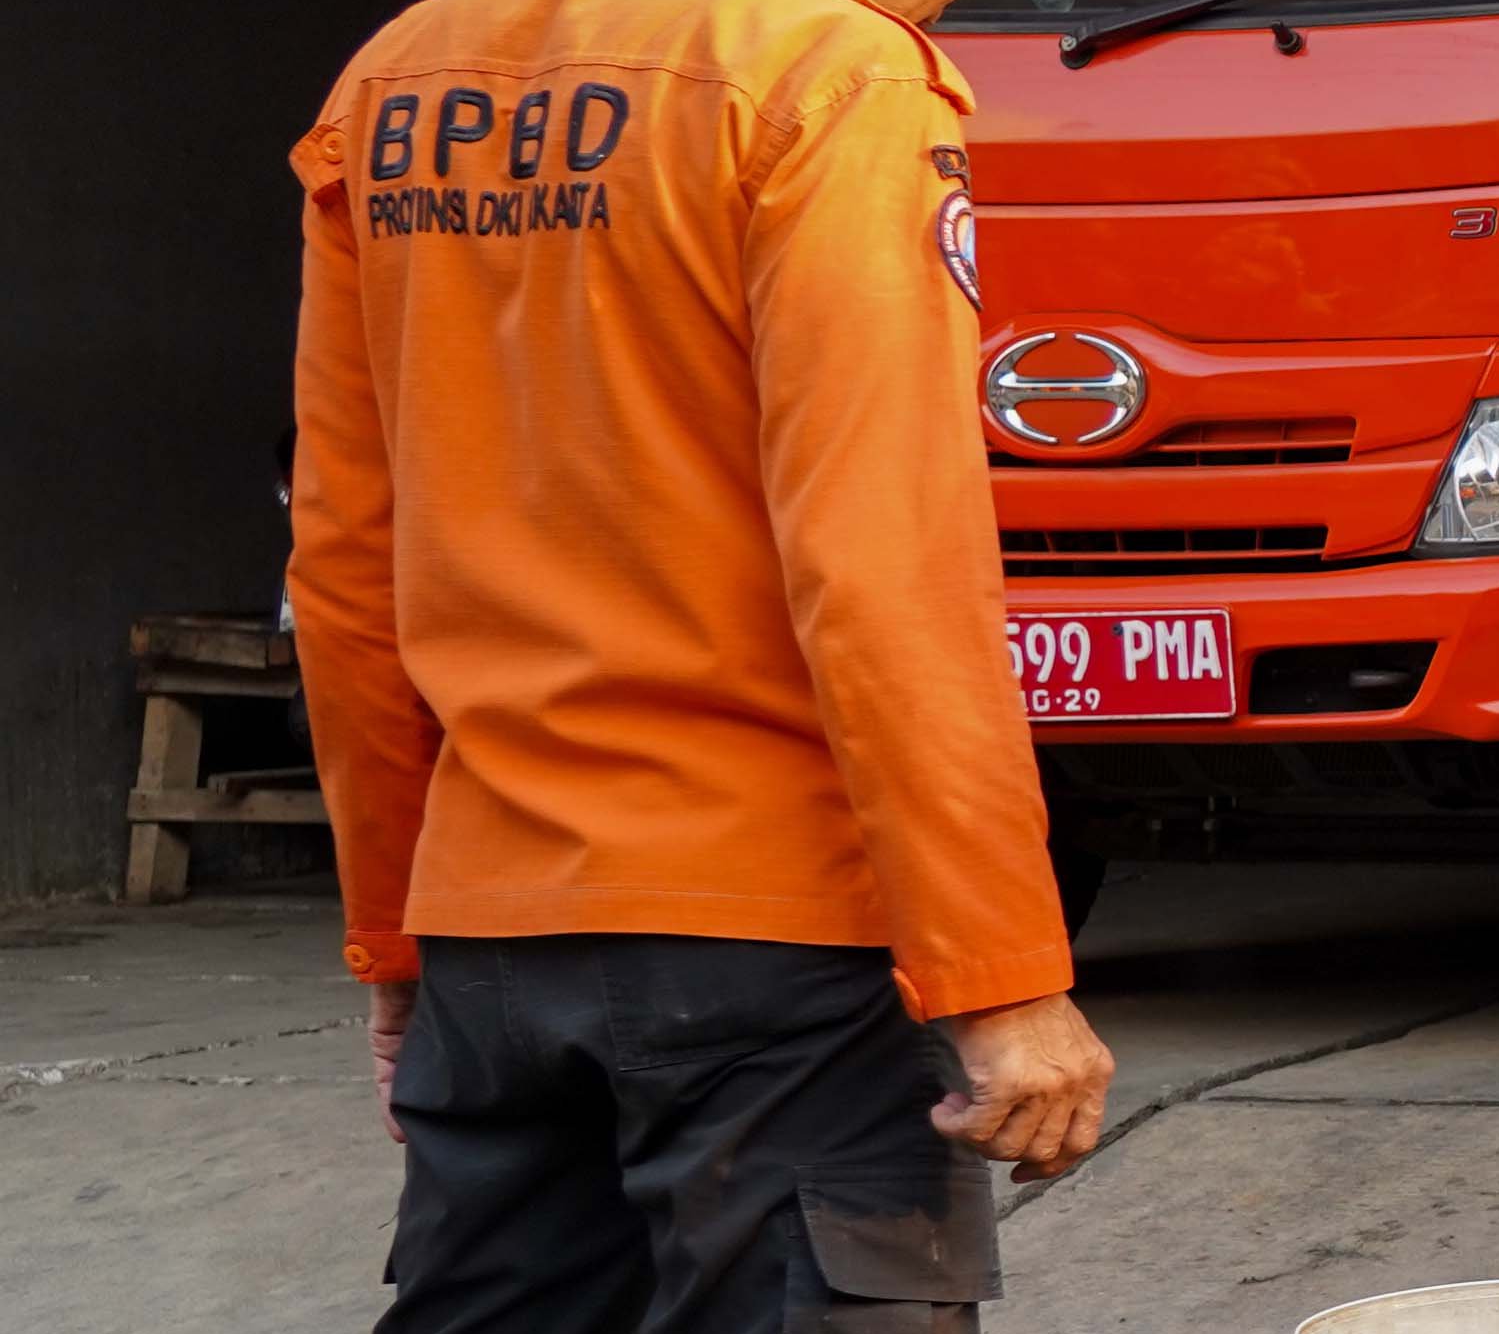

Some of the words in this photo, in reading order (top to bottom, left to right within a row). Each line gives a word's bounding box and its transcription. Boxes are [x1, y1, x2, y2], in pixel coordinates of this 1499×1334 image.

[370, 82, 629, 181] BPBD
[475, 190, 523, 237] DKI
[1121, 620, 1222, 681] PMA
